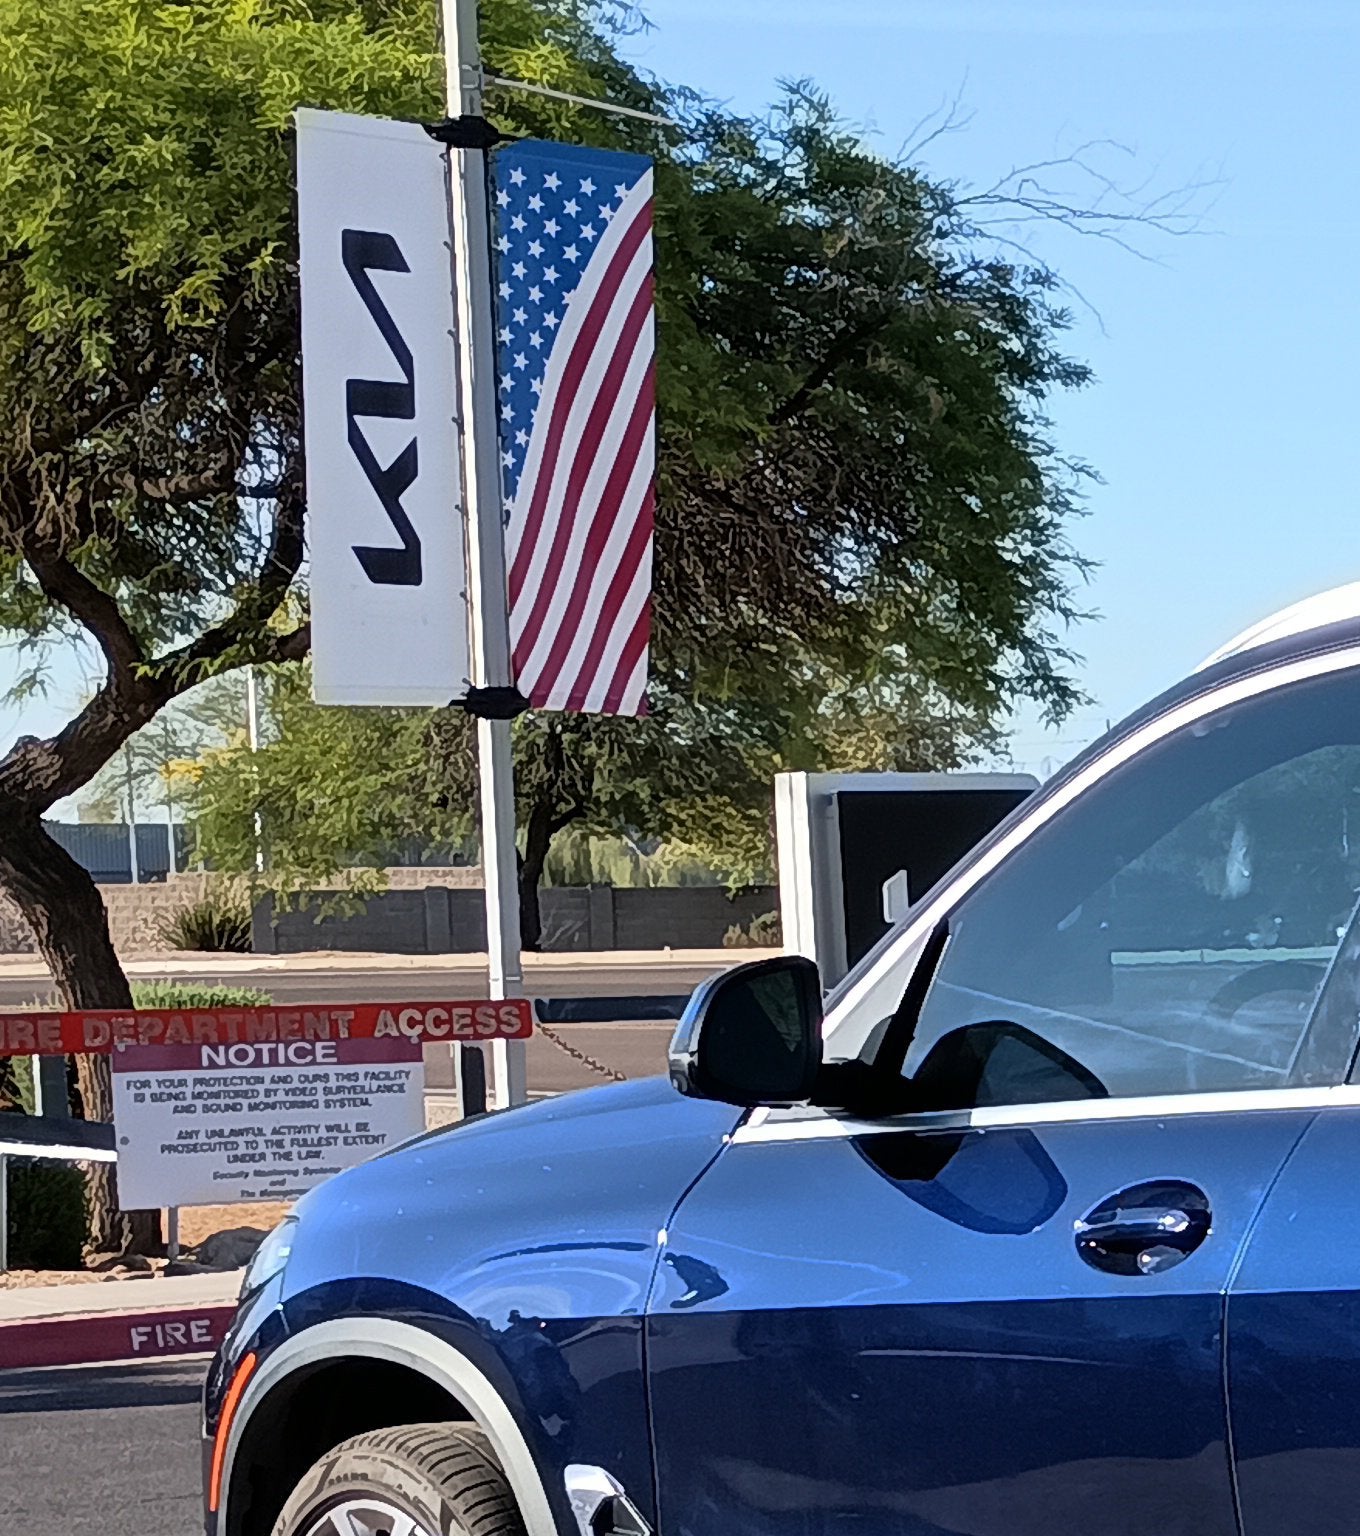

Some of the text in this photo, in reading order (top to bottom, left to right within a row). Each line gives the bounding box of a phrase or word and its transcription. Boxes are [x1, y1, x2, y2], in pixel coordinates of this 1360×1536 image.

[83, 1010, 355, 1047] DEPARTMENT
[374, 1006, 522, 1038] ACCESS
[201, 1041, 338, 1067] NOTICE
[126, 1070, 411, 1090] FOR YOUR PROTECTION AND OURS THIS FACILITY
[191, 1089, 260, 1101] MONITORED
[264, 1088, 281, 1098] BY
[283, 1087, 318, 1097] VIDEO
[322, 1083, 406, 1095] SURVEILLANCE
[176, 1129, 200, 1140] ANY
[205, 1127, 266, 1139] UNLAWFUL
[271, 1124, 321, 1136] ACTIVITY
[325, 1123, 351, 1133] WILL
[160, 1133, 387, 1154] PROSECUTED TO THE FULLEST EXTENT
[227, 1152, 266, 1164] UNDER
[271, 1151, 293, 1161] THE
[130, 1319, 213, 1351] FIRE
